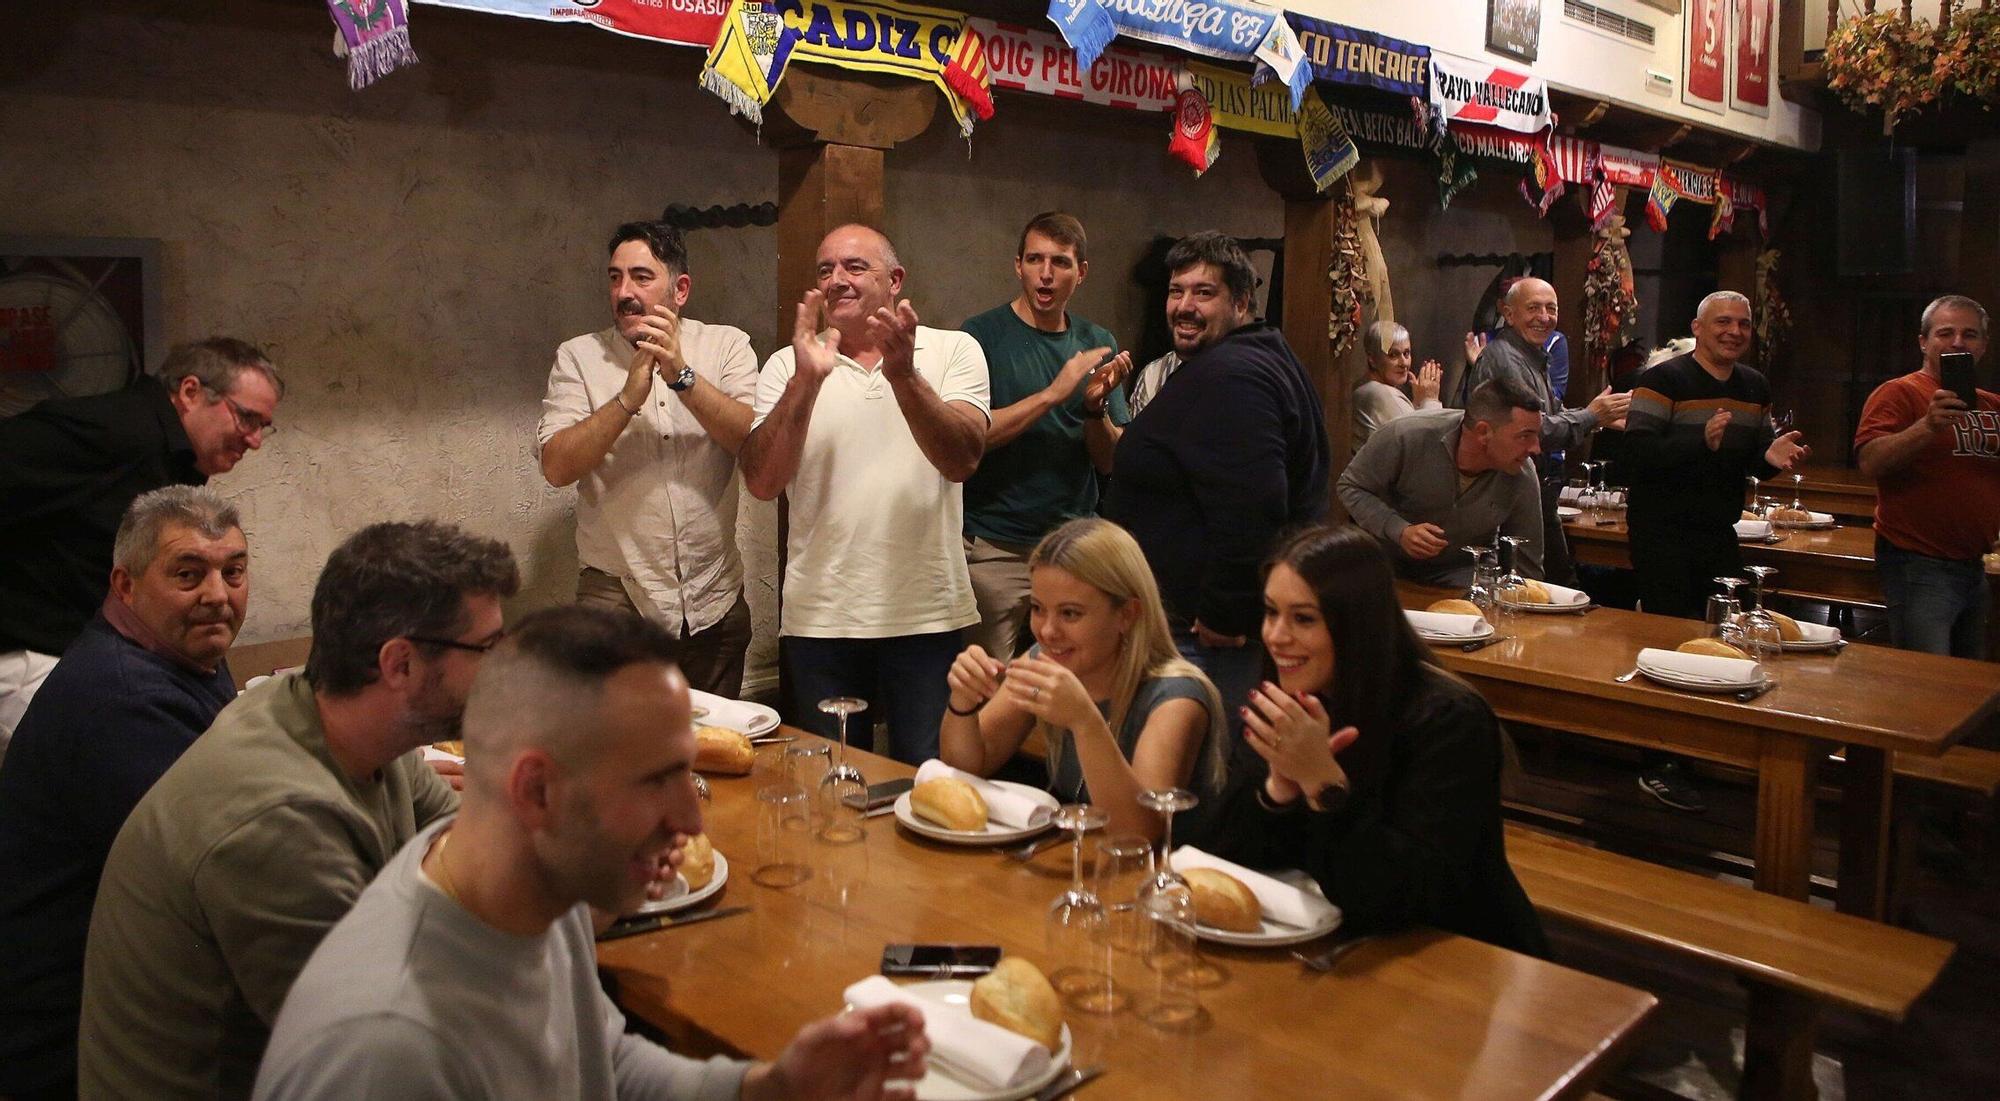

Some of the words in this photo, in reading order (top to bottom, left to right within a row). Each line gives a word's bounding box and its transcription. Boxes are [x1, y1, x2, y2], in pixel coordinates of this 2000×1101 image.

[671, 0, 730, 16] OSASU
[779, 0, 922, 58] CADIZ
[1042, 46, 1083, 88] PEL
[1090, 56, 1180, 101] GIRONA
[1300, 30, 1331, 66] CD
[1334, 40, 1429, 85] TENERIFE
[1219, 81, 1246, 117] LAS
[1250, 87, 1300, 125] PALMA
[1438, 71, 1472, 103] RAYO
[1474, 81, 1543, 117] VALLECANO
[1363, 111, 1395, 144] BETIS
